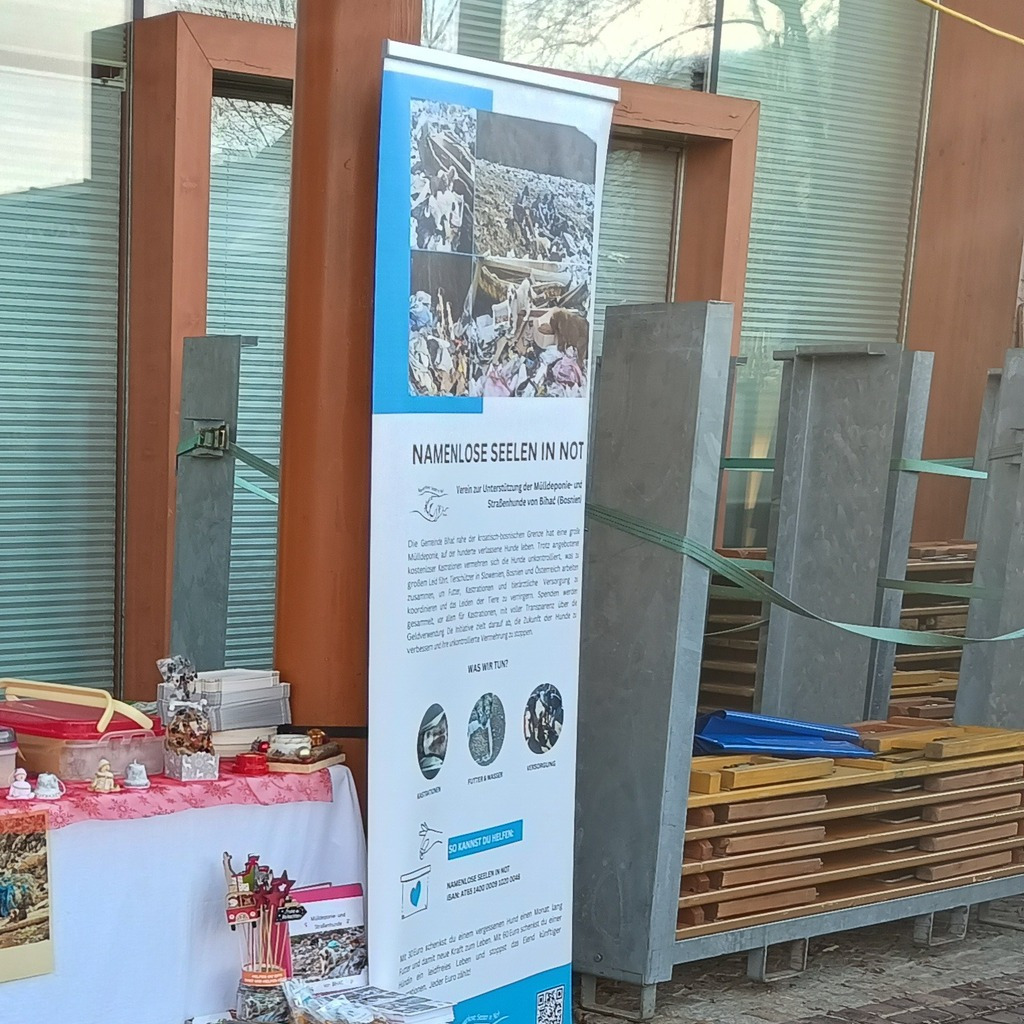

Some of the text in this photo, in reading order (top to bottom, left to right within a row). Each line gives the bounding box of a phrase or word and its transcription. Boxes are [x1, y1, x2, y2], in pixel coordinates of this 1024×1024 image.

[413, 441, 584, 465] NAMENLOSE SEELEN IN NOT
[456, 480, 583, 494] Verein zur Unterstützung der Mülldeponie- und
[488, 498, 526, 508] Straßenhunde
[408, 540, 418, 548] Die
[468, 660, 508, 674] WAS WIR TUN?
[468, 776, 483, 785] FUTTER
[448, 844, 456, 854] SO
[458, 838, 482, 851] KANNST
[483, 835, 491, 845] DU
[447, 875, 477, 889] NAMENLOSE
[552, 903, 563, 912] lang
[541, 918, 547, 926] du
[456, 957, 472, 967] Leben
[476, 950, 485, 961] und
[445, 975, 456, 984] Euro
